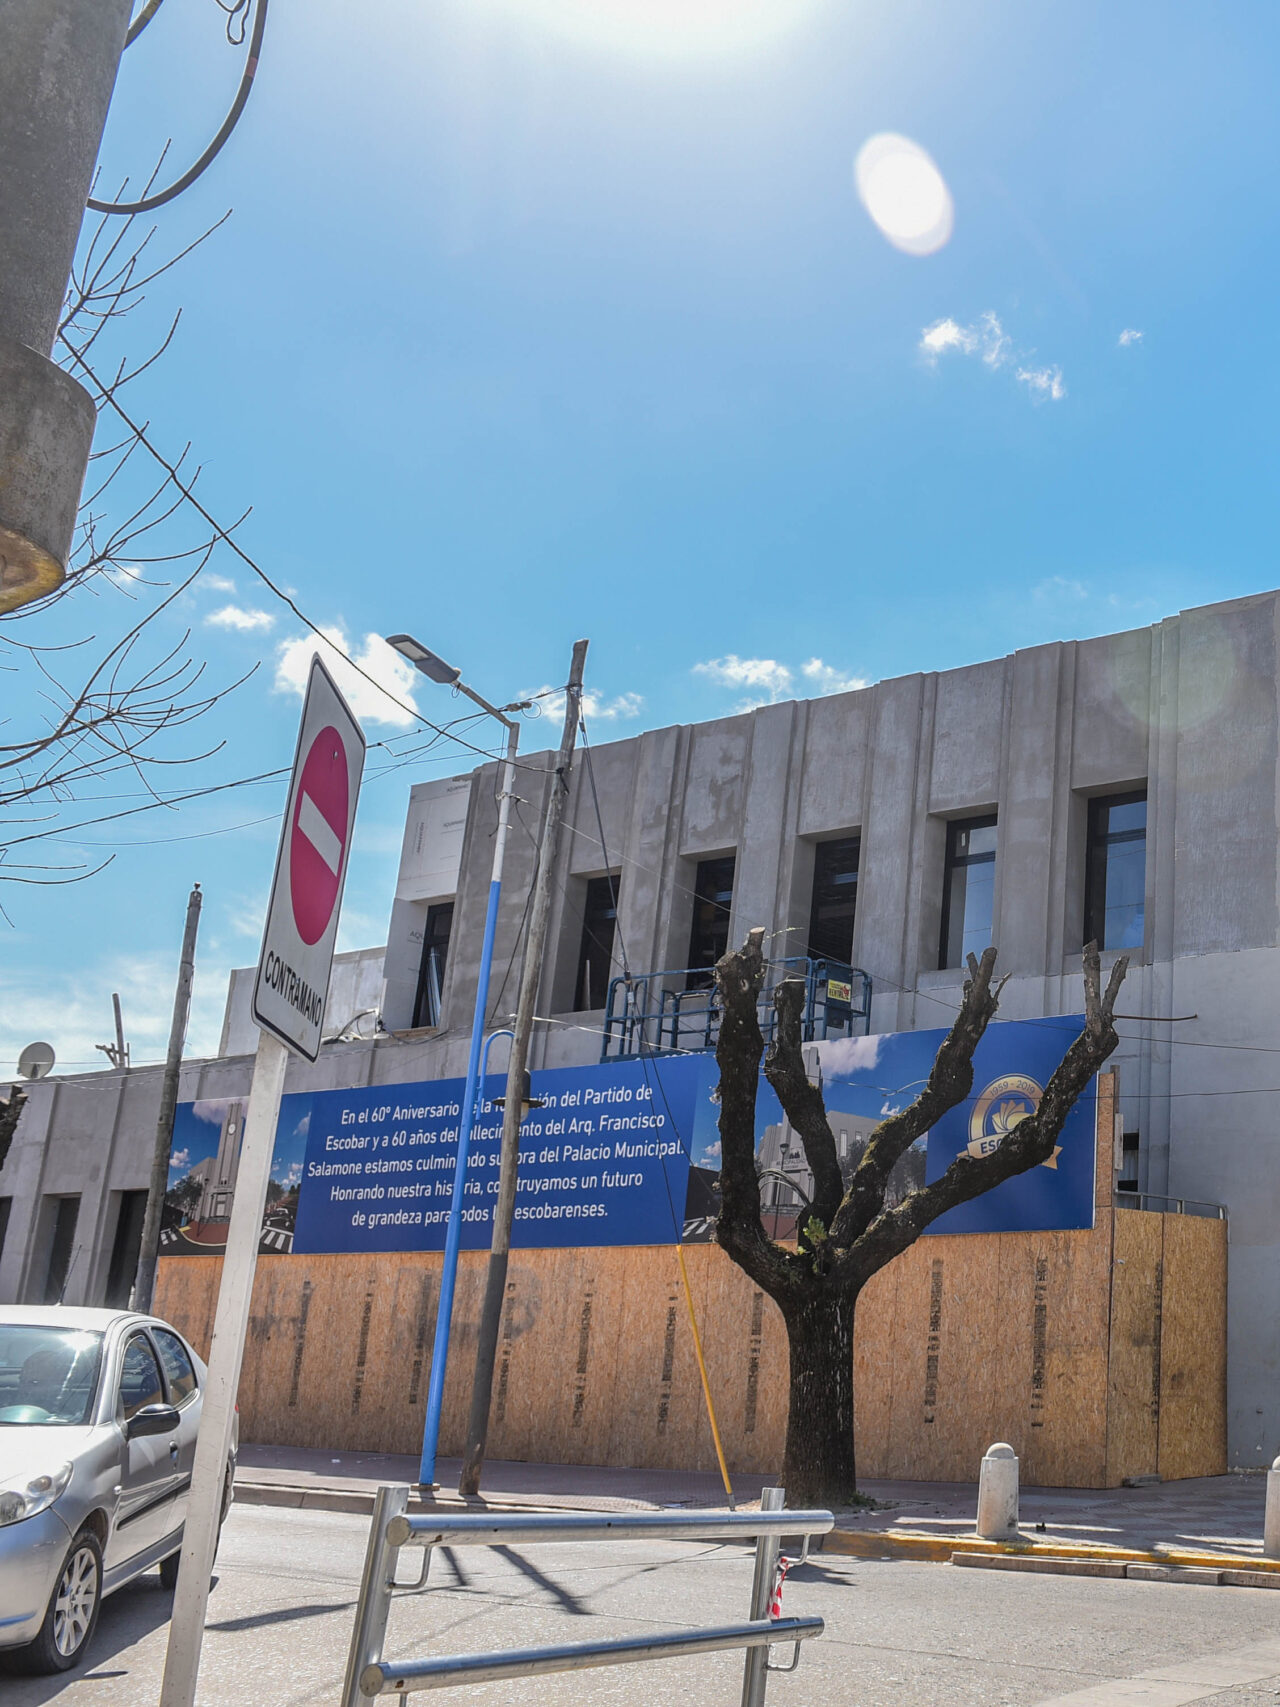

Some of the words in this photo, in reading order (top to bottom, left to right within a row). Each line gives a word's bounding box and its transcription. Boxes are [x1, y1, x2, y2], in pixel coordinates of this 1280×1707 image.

[265, 950, 322, 1028] CONTRAMANO
[341, 1109, 355, 1125] En
[358, 1107, 369, 1124] el
[393, 1101, 460, 1120] Aniversario
[481, 1098, 491, 1114] la
[560, 1089, 581, 1108] del
[584, 1085, 632, 1105] Partido
[636, 1083, 653, 1101] de
[991, 1081, 1009, 1097] 1959
[1016, 1080, 1036, 1095] 2019
[325, 1134, 371, 1151] Escobar
[372, 1136, 380, 1151] y
[381, 1135, 389, 1148] a
[391, 1131, 407, 1147] 60
[409, 1128, 437, 1145] años
[440, 1126, 459, 1143] del
[469, 1120, 542, 1141] llecinto
[545, 1118, 565, 1136] del
[568, 1116, 596, 1136] Arq.
[599, 1112, 665, 1132] Francisco
[308, 1160, 362, 1177] Salamone
[365, 1157, 413, 1174] estamos
[416, 1150, 486, 1171] culmindo
[539, 1145, 560, 1163] del
[563, 1141, 611, 1162] Palacio
[614, 1139, 685, 1161] Municipal.
[330, 1184, 385, 1201] Honrando
[387, 1181, 431, 1199] nuestra
[434, 1178, 484, 1197] hisria,
[486, 1176, 577, 1195] cotruyamos
[581, 1175, 598, 1189] un
[601, 1171, 643, 1188] futuro
[351, 1210, 366, 1226] de
[368, 1208, 422, 1229] grandeza
[424, 1211, 452, 1227] para
[461, 1205, 489, 1222] odos
[514, 1202, 608, 1220] escobarenses.
